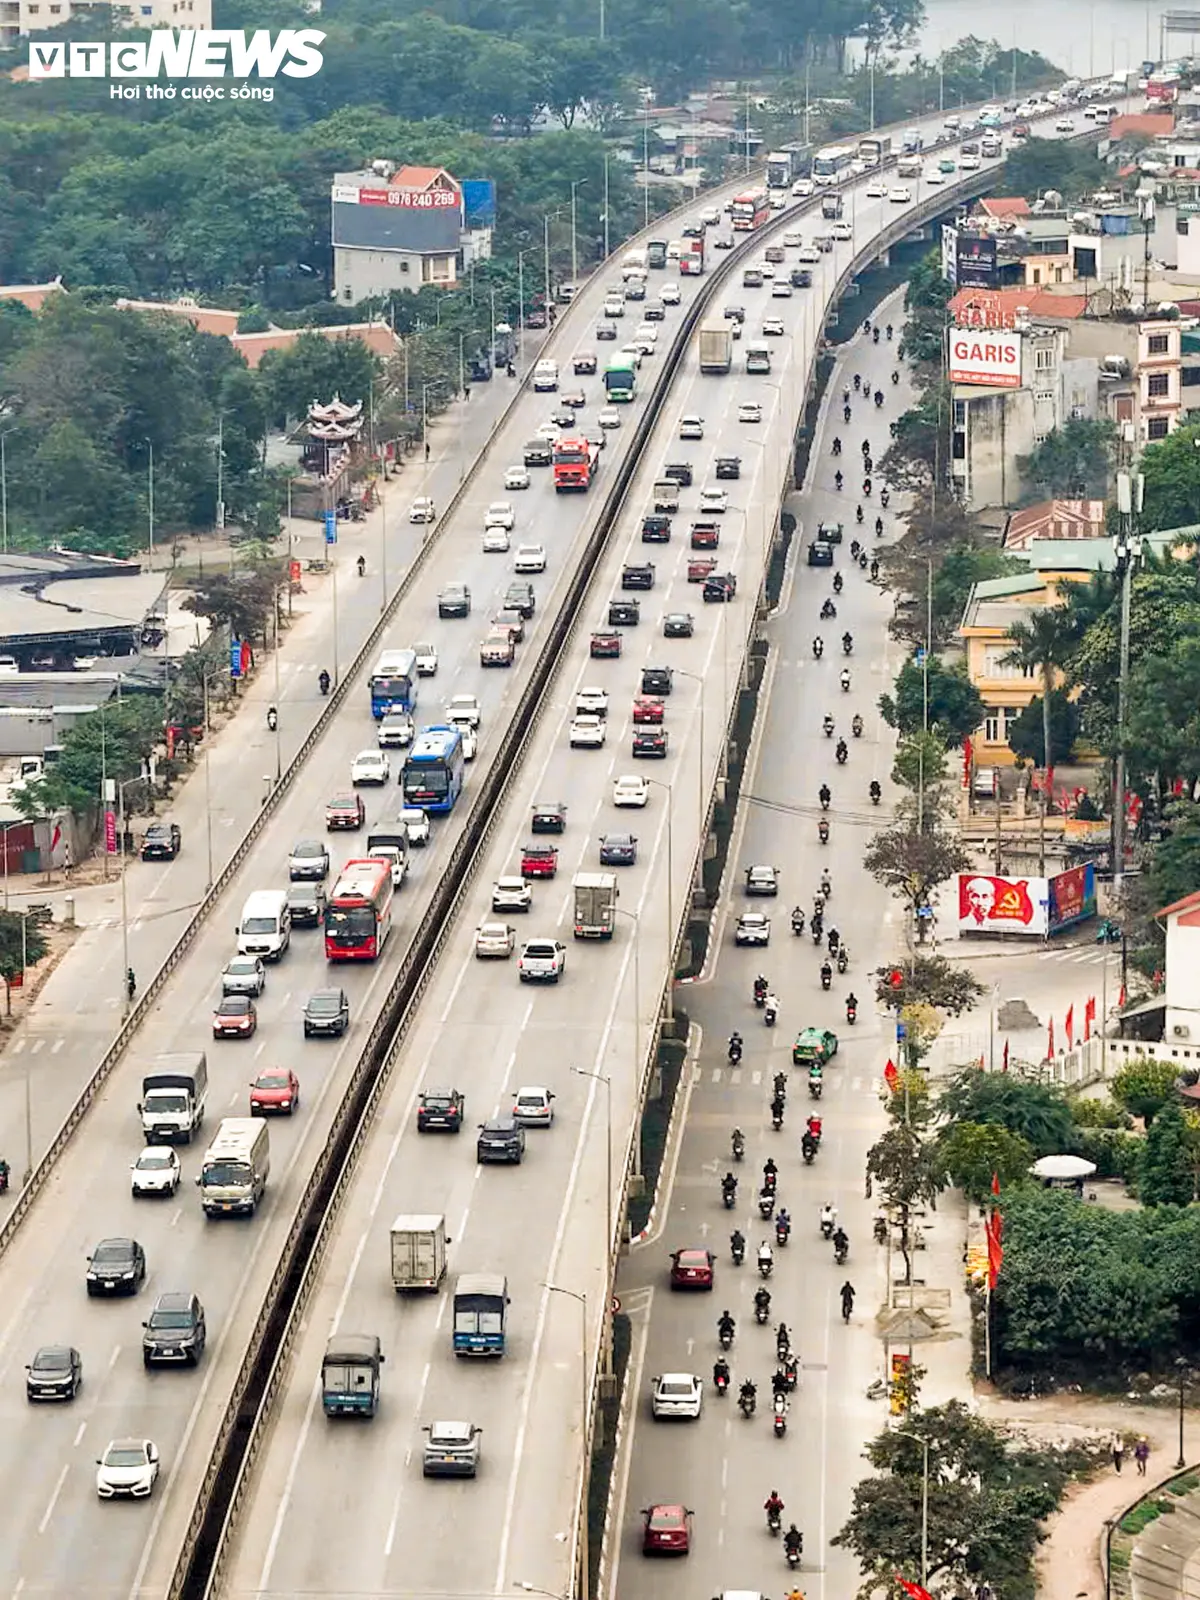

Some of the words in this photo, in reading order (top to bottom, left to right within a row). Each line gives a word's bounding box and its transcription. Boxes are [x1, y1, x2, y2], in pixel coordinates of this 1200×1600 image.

[412, 194, 432, 206] 240
[434, 193, 455, 205] 269
[955, 309, 1015, 328] GARIS
[955, 342, 1016, 364] GARIS
